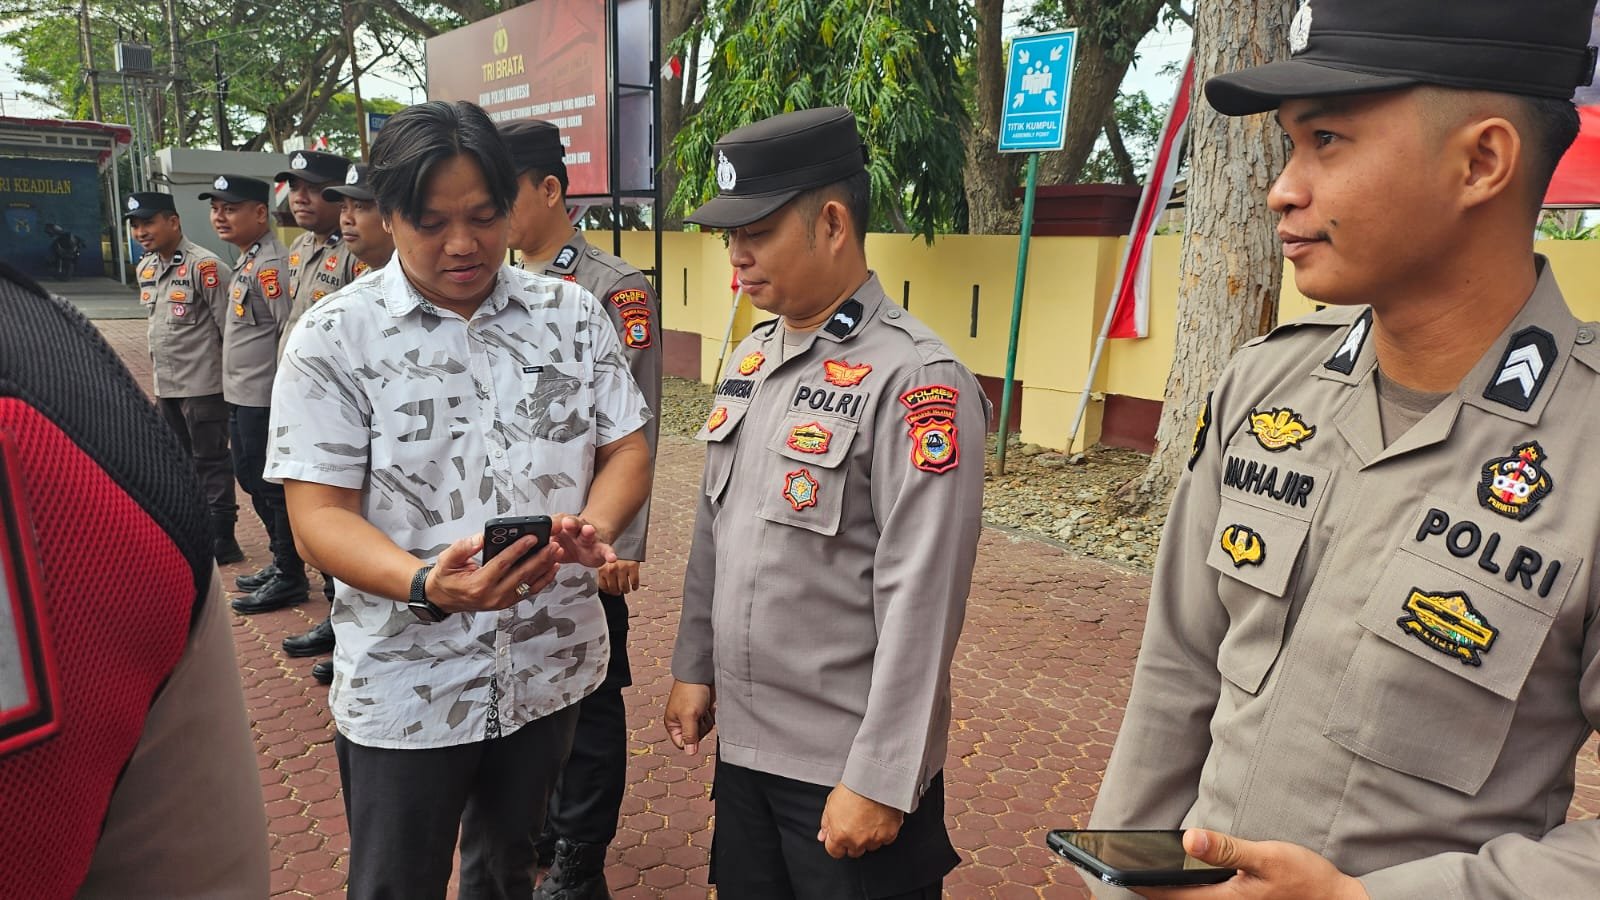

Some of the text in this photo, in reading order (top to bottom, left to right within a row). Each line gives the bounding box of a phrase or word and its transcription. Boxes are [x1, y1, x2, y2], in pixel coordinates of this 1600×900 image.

[481, 54, 525, 82] TRI BRATA
[1008, 120, 1057, 131] TITIK KUMPUL
[14, 176, 72, 195] KEADILAN
[171, 279, 190, 287] POLRI
[316, 271, 340, 287] POLRI
[794, 385, 862, 418] POLRI
[906, 388, 953, 403] POLRES
[1223, 455, 1314, 508] MUHAJIR
[1415, 507, 1561, 598] POLRI
